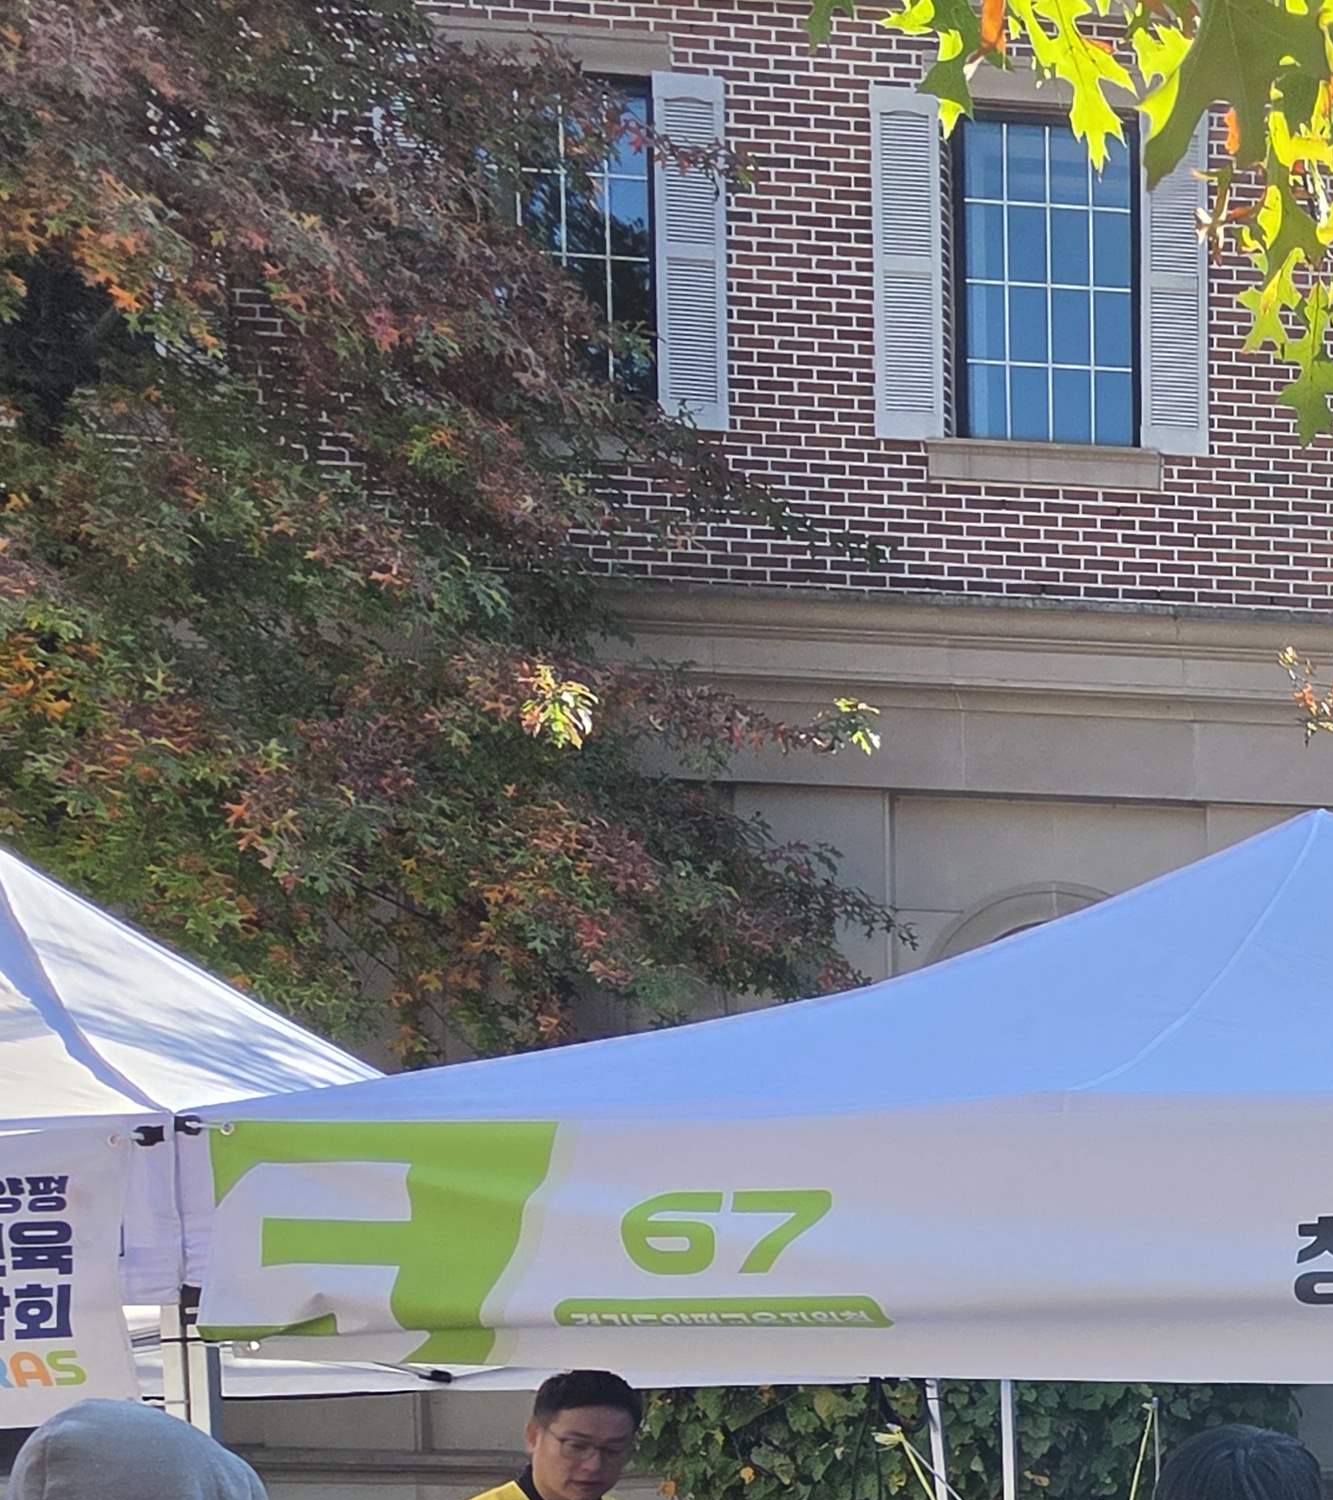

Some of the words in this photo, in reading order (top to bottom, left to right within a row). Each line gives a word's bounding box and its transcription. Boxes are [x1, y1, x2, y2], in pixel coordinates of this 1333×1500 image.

[0, 1220, 74, 1276] 육
[620, 1188, 833, 1276] 67
[0, 1283, 74, 1341] 회
